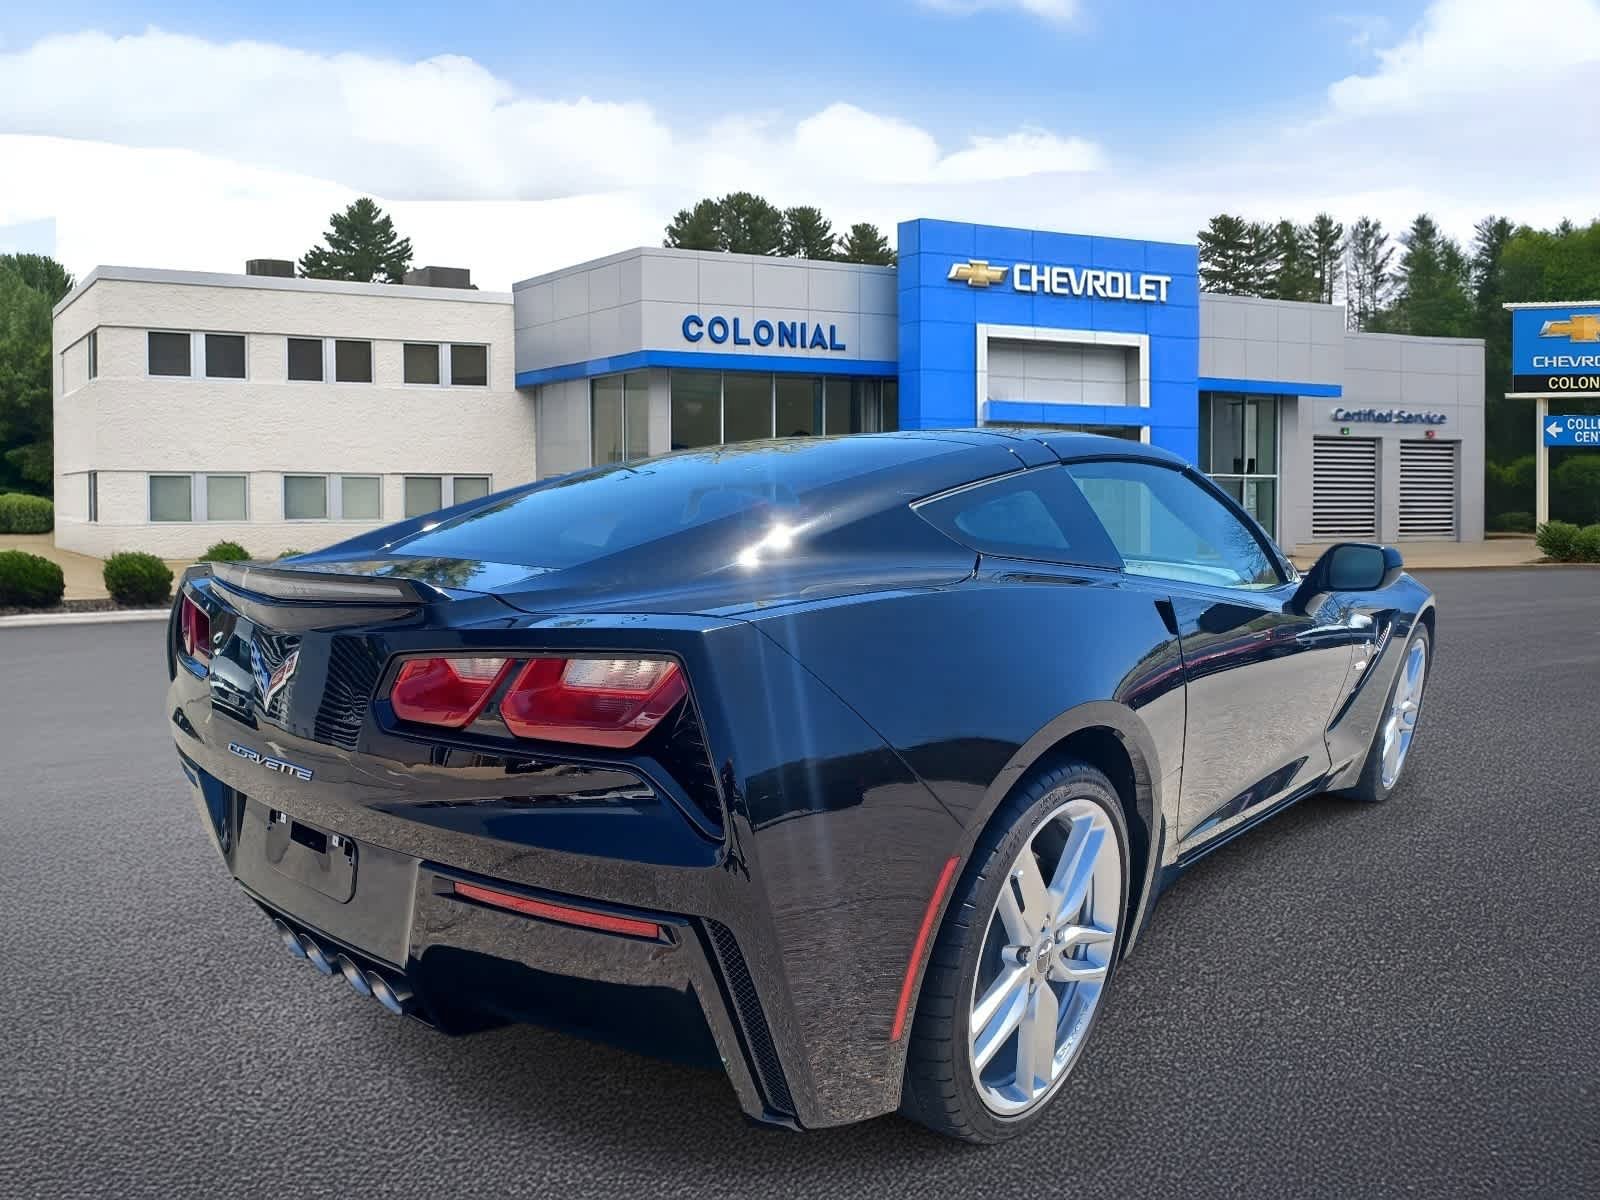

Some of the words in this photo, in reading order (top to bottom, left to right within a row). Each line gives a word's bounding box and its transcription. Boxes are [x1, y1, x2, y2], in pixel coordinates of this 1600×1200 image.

[1013, 263, 1172, 302] CHEVROLET
[682, 315, 846, 350] COLONIAL
[1332, 408, 1393, 424] Certified
[1394, 410, 1447, 425] Service
[1575, 431, 1600, 443] CEN
[228, 742, 313, 781] CORVETTE
